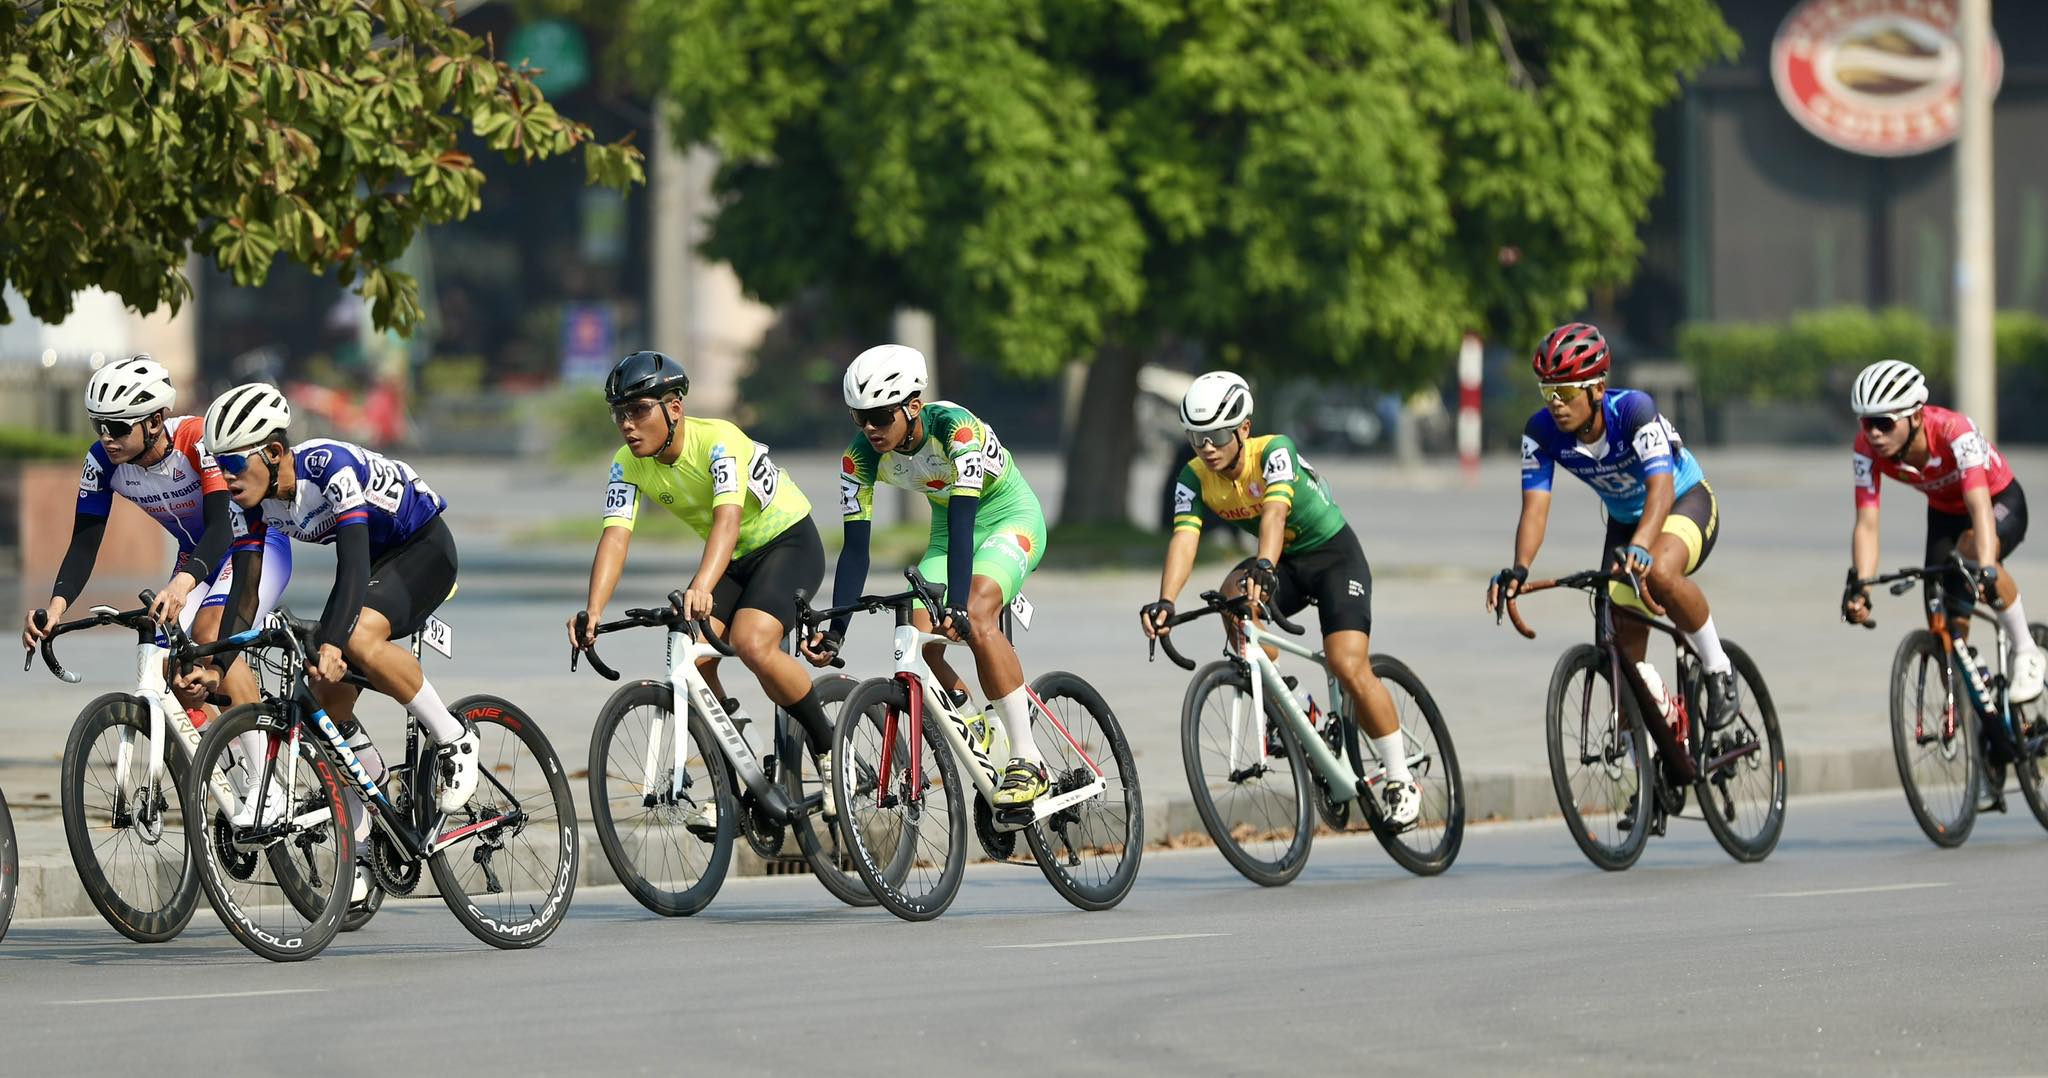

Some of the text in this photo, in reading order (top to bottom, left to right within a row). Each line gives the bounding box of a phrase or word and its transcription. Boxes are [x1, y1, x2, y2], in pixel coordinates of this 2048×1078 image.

[1640, 431, 1662, 450] 72
[373, 459, 405, 500] 92
[963, 458, 982, 478] 55
[328, 476, 357, 503] 92
[607, 488, 627, 508] 65
[169, 499, 196, 511] Long
[431, 619, 444, 645] 92
[929, 684, 999, 788] SAVA
[318, 713, 379, 799] GIANT
[467, 826, 574, 937] CAMPAGNOLO
